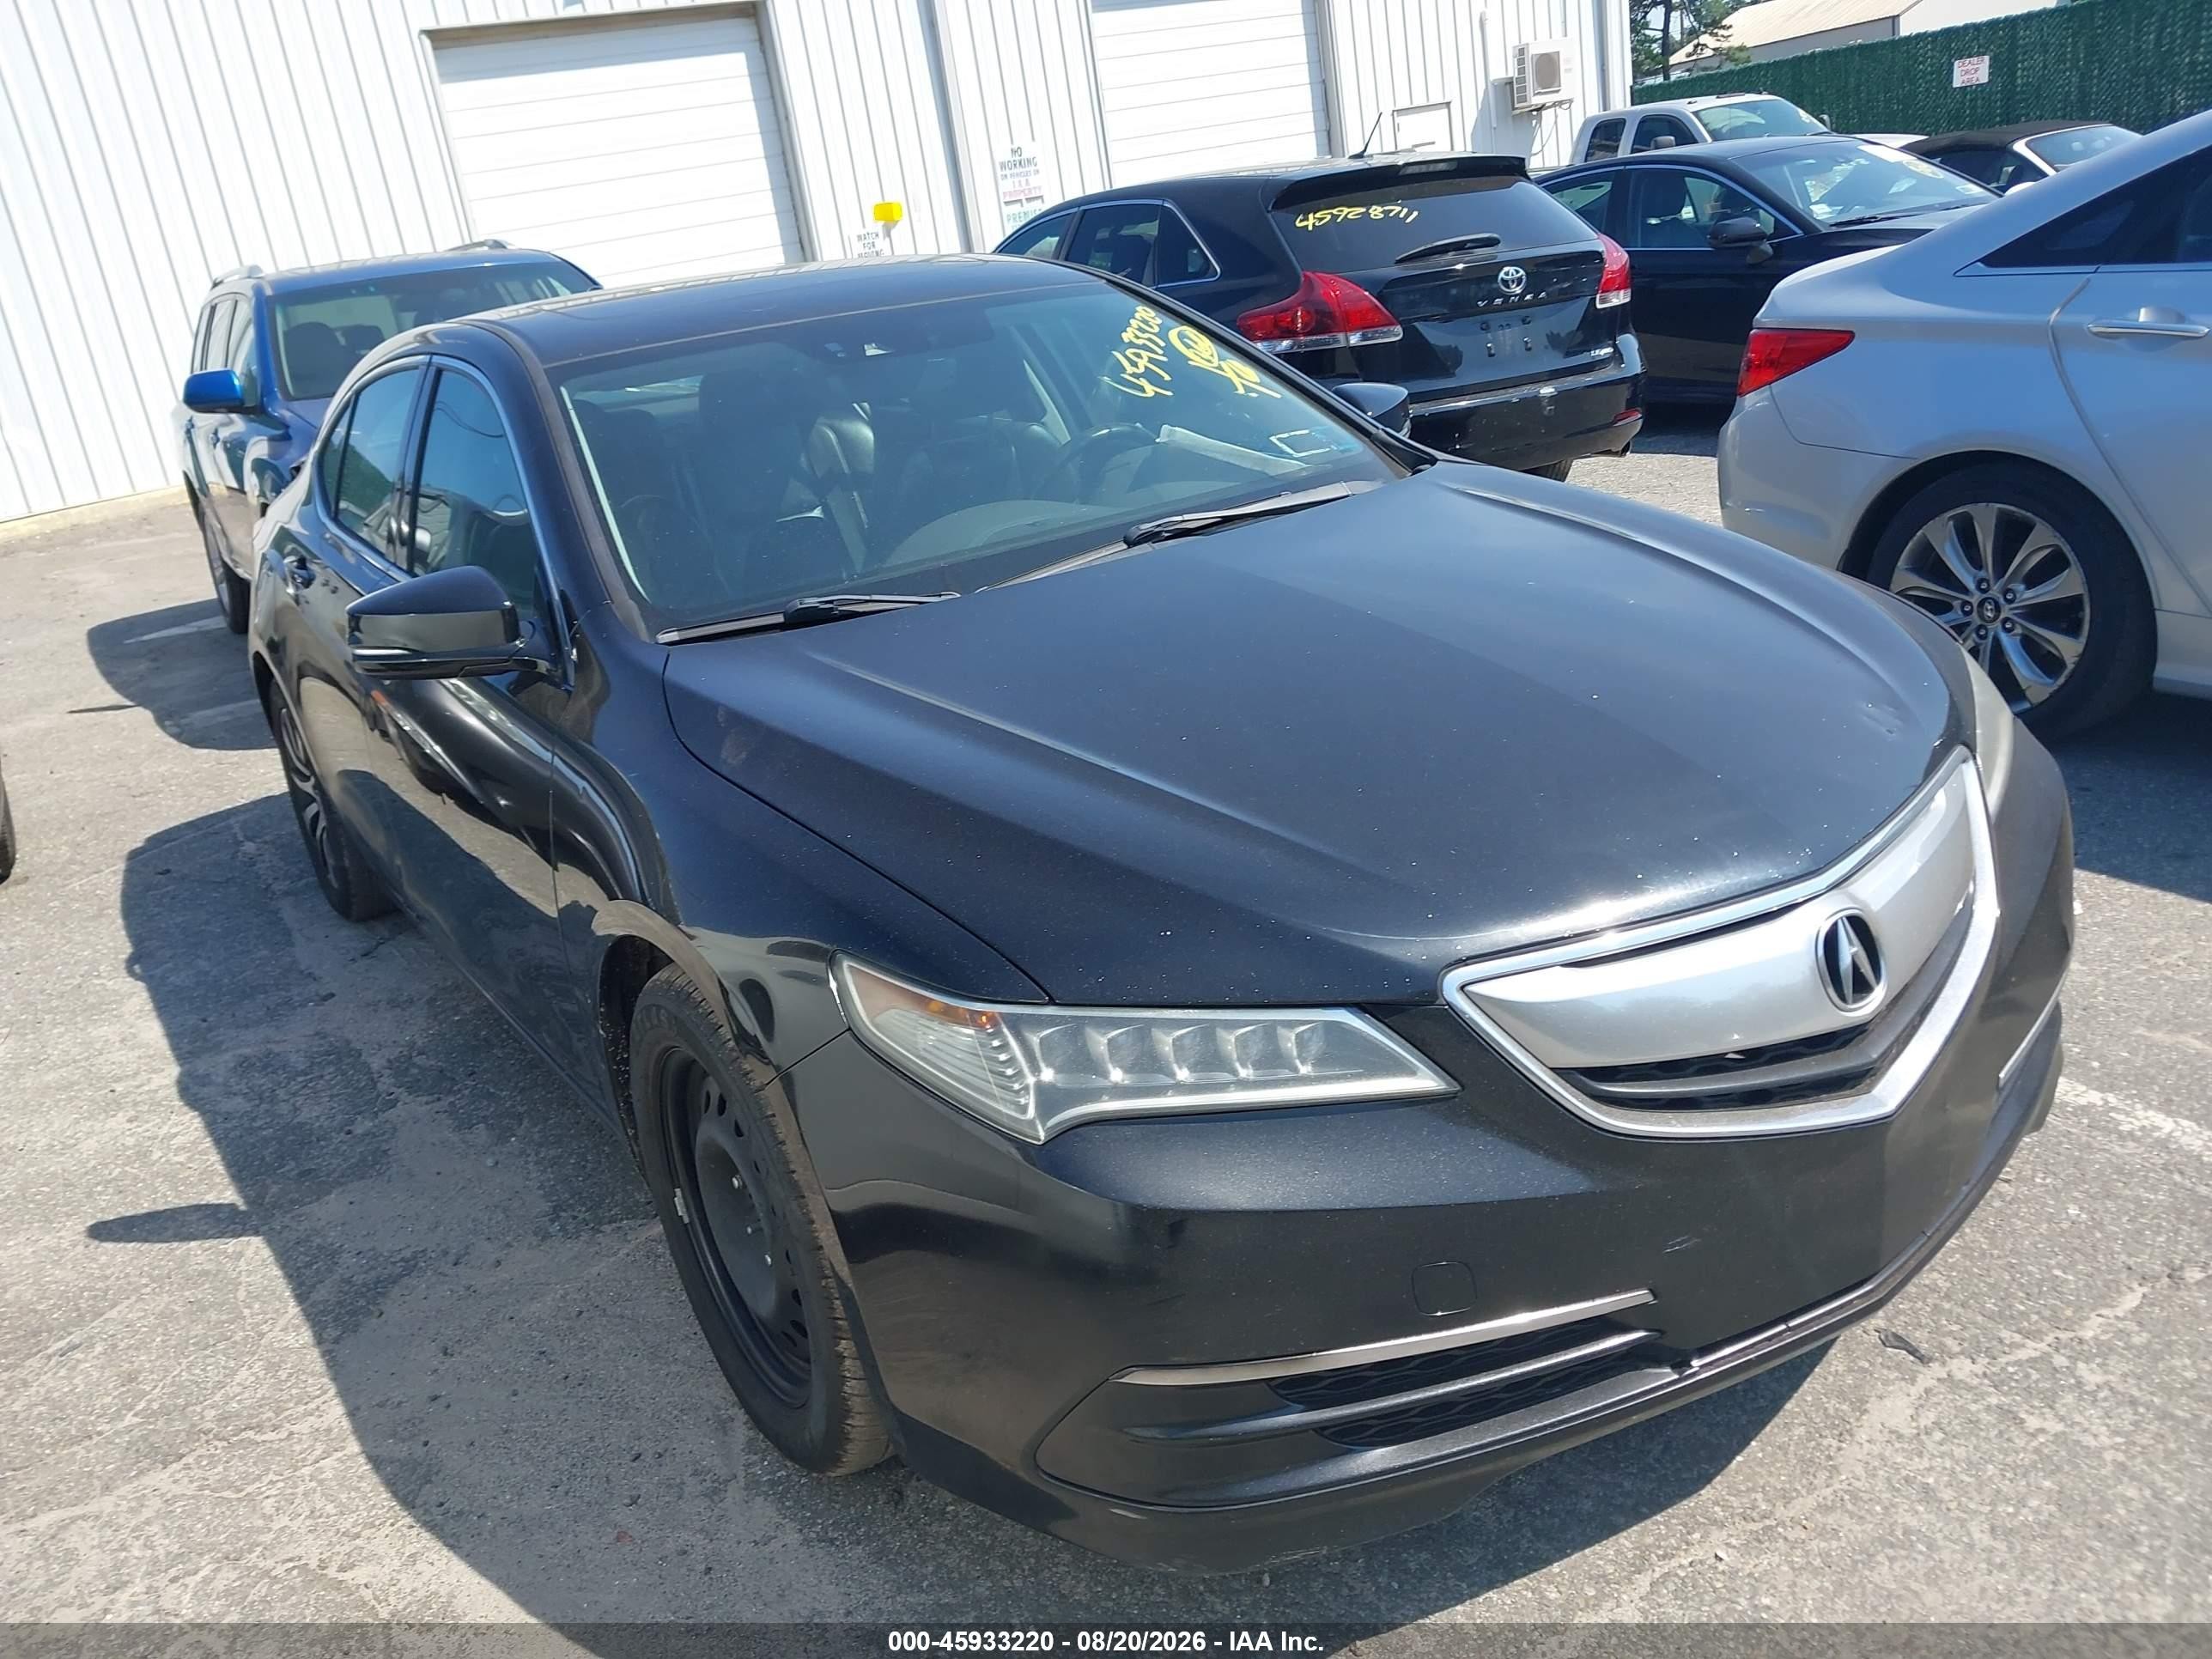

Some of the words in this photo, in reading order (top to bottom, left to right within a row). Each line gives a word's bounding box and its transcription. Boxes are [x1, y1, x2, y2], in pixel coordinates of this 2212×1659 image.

[1958, 57, 1985, 68] DEALER
[1960, 67, 1979, 76] DROP
[1011, 146, 1023, 158] NO
[999, 156, 1037, 172] WORKING
[1002, 185, 1042, 200] PROPERTY
[856, 231, 880, 242] WATCH
[862, 240, 876, 250] FOR
[1477, 291, 1547, 307] VENZA
